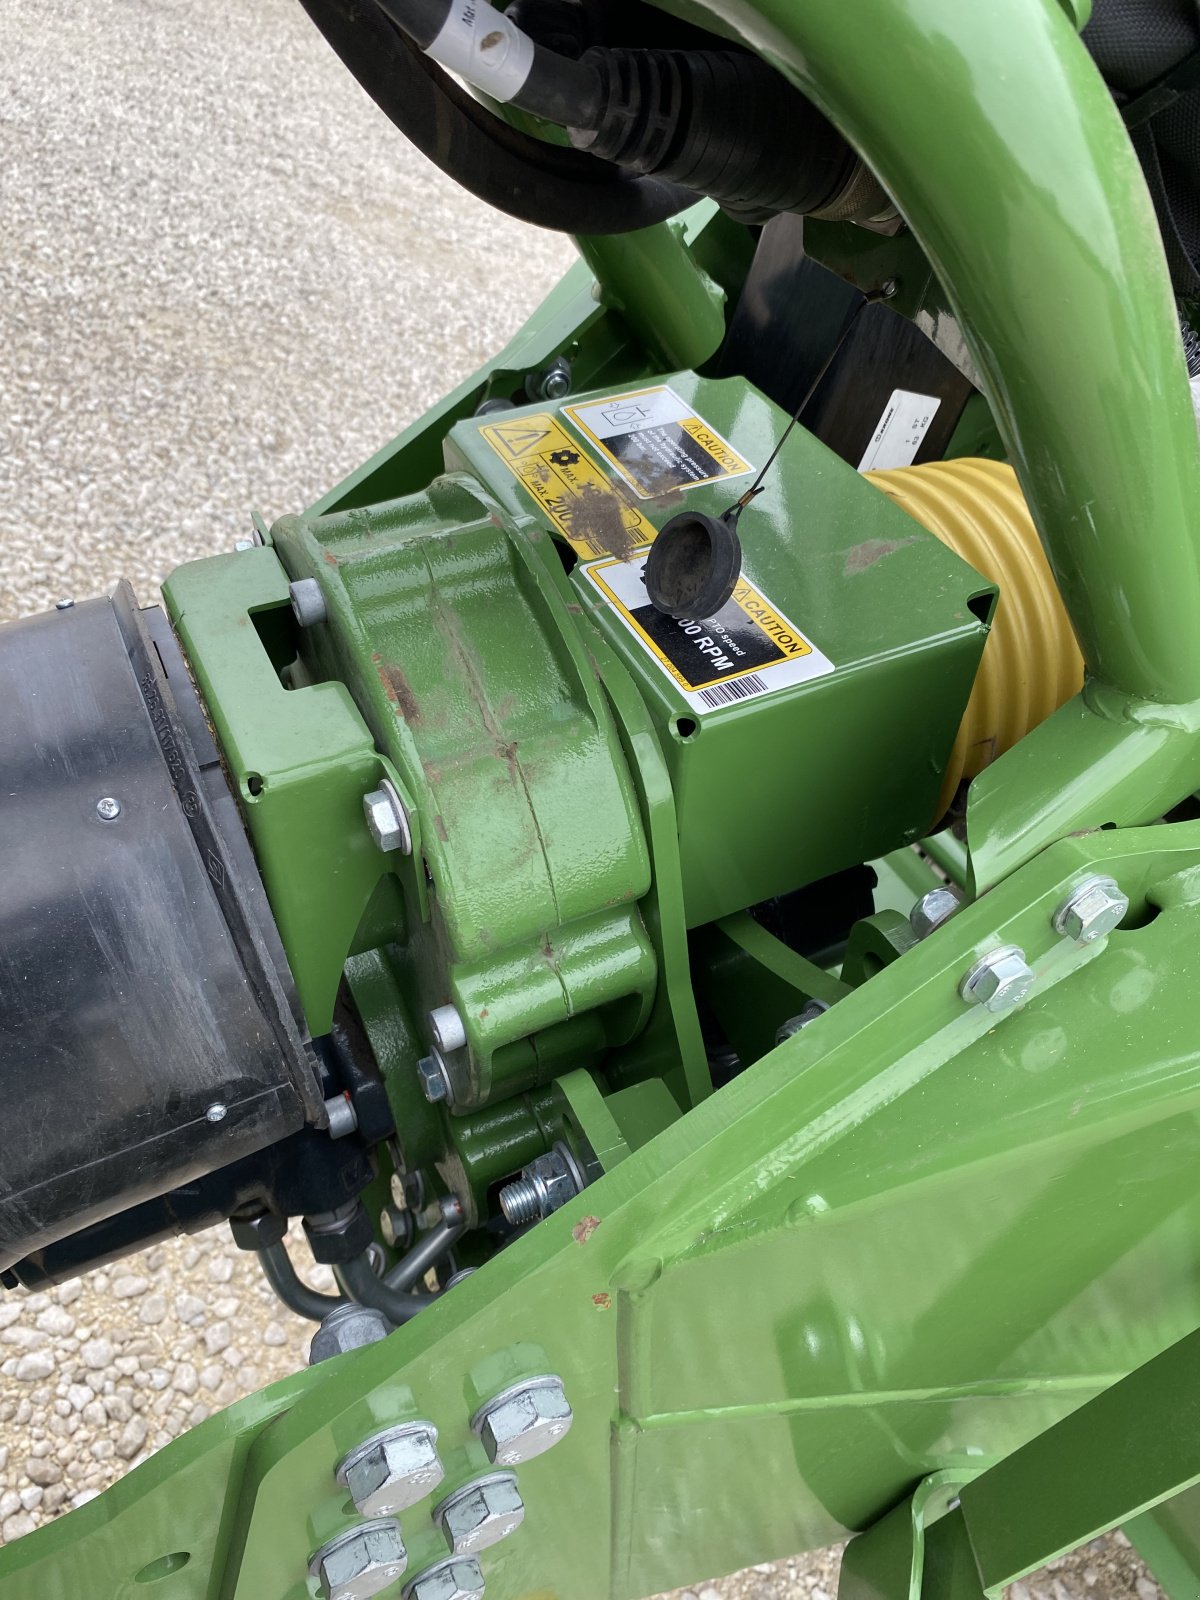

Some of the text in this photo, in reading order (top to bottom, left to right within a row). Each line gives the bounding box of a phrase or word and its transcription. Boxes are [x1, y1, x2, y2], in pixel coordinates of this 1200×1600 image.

[638, 432, 677, 469] must not exceed
[652, 433, 662, 445] the
[660, 442, 683, 464] hydraulic
[680, 463, 701, 481] system
[657, 427, 709, 479] The operating pressure
[697, 433, 741, 471] CAUTION
[560, 466, 578, 485] MAX.
[530, 480, 574, 522] MAX. 200
[707, 619, 746, 657] PTO speed
[744, 600, 802, 654] CAUTION
[660, 656, 670, 665] 27
[666, 663, 677, 675] 004
[694, 636, 734, 671] RPM
